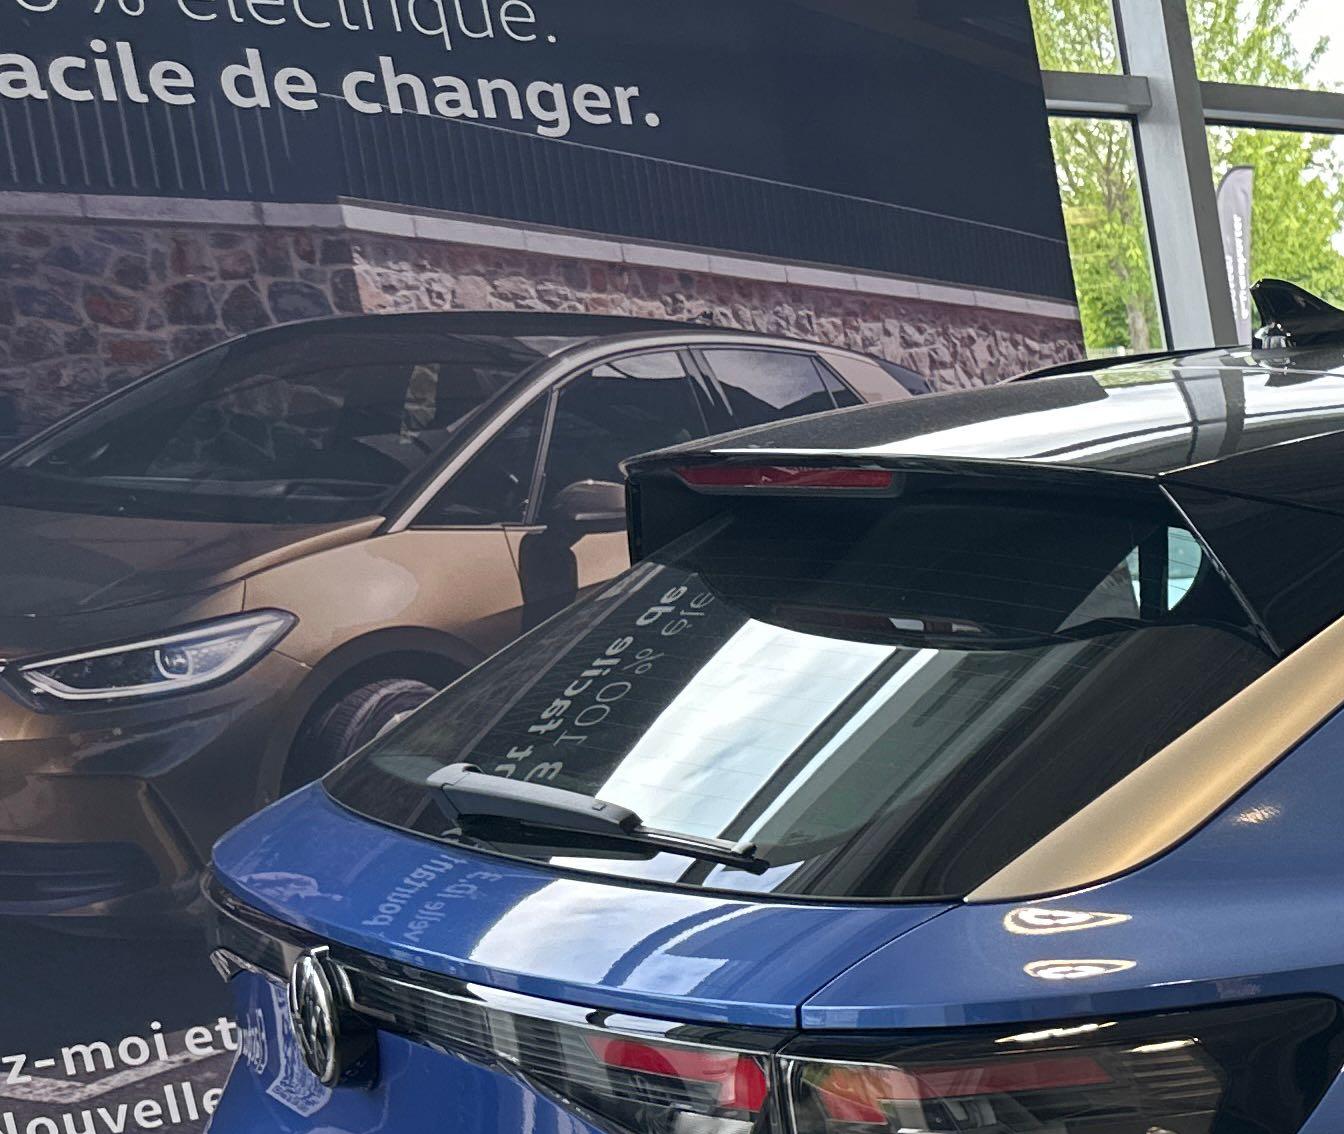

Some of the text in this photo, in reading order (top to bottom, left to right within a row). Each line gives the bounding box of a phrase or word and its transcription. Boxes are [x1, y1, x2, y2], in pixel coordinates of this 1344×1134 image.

[220, 48, 318, 112] de
[342, 56, 661, 138] changer.
[184, 1015, 239, 1056] et
